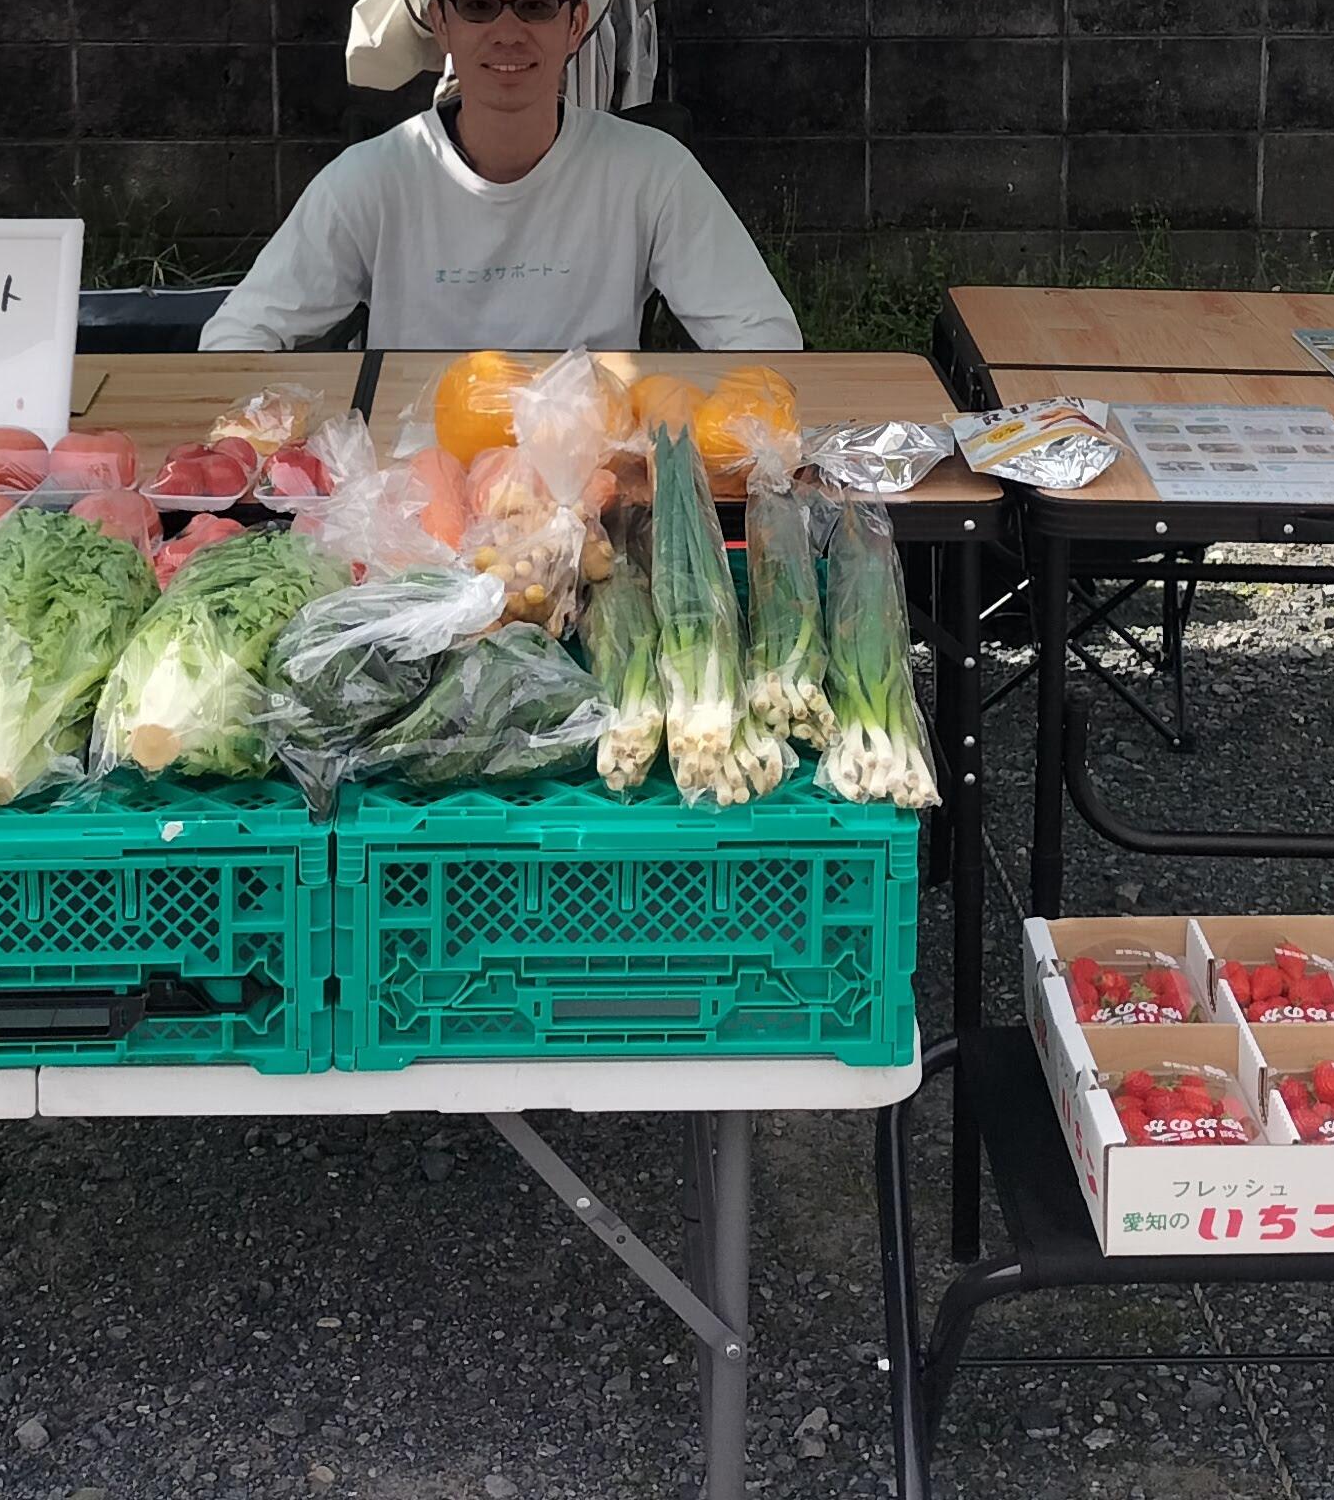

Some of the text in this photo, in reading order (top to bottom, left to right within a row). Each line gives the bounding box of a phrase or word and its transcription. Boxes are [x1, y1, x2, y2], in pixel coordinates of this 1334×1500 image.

[435, 263, 553, 283] まごころサポート
[1171, 1179, 1289, 1198] フレッシュ
